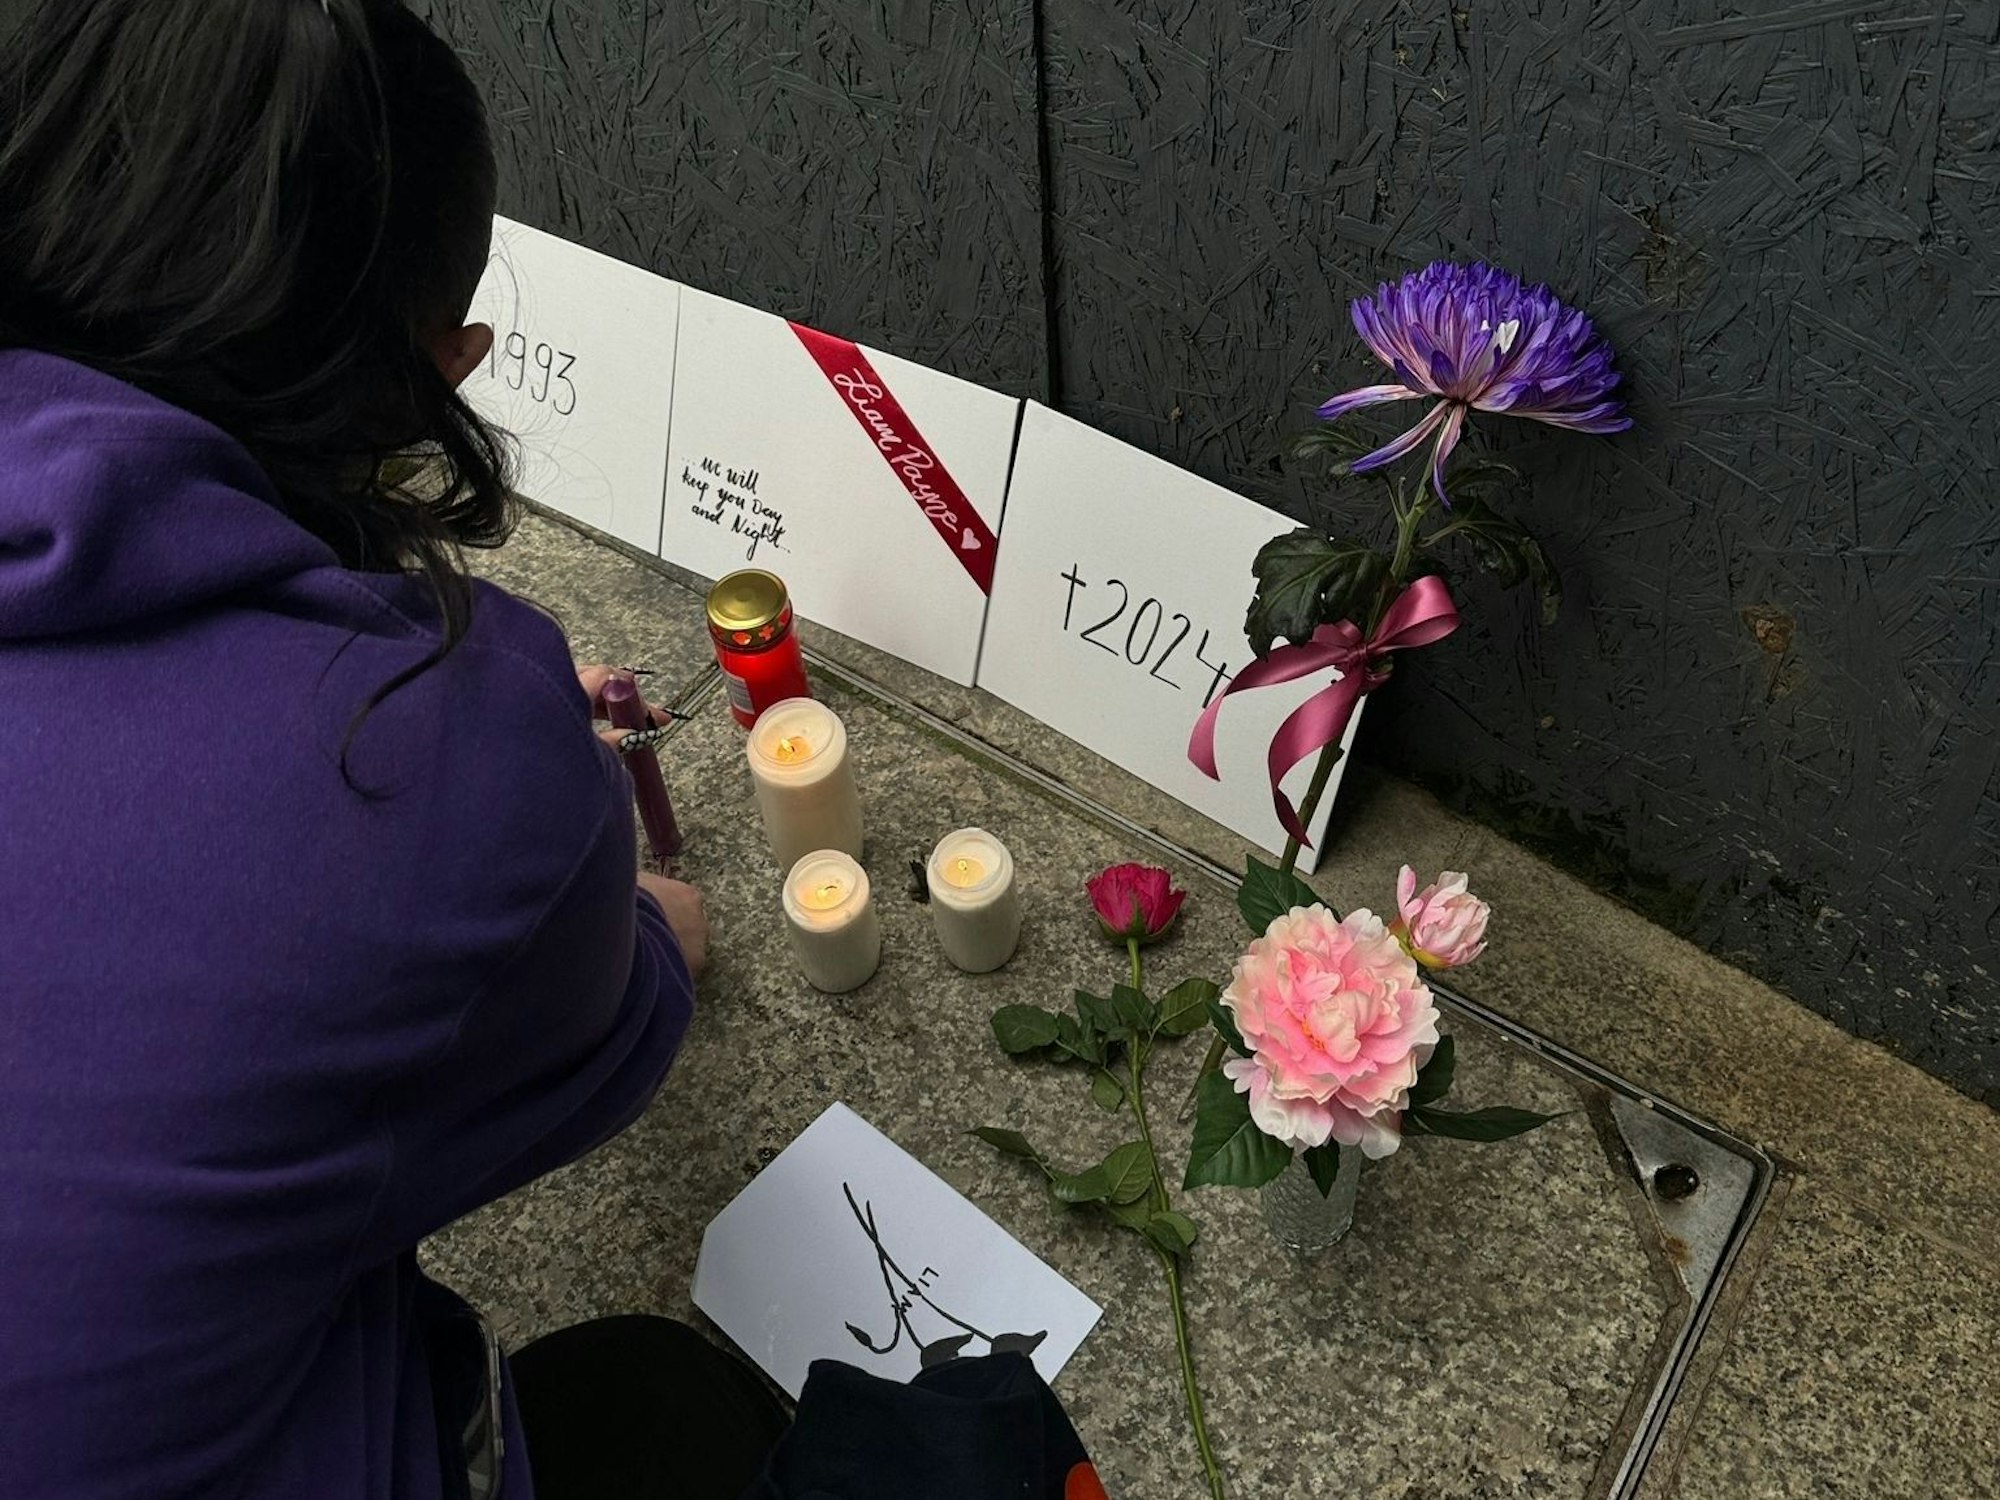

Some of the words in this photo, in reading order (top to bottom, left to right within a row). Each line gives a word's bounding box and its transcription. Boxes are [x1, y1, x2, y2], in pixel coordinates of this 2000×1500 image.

[490, 322, 577, 415] 1993
[833, 367, 902, 451] Liam
[890, 443, 958, 533] Payne
[682, 465, 709, 502] keep
[715, 487, 745, 511] you
[727, 468, 759, 495] will
[692, 505, 724, 525] and
